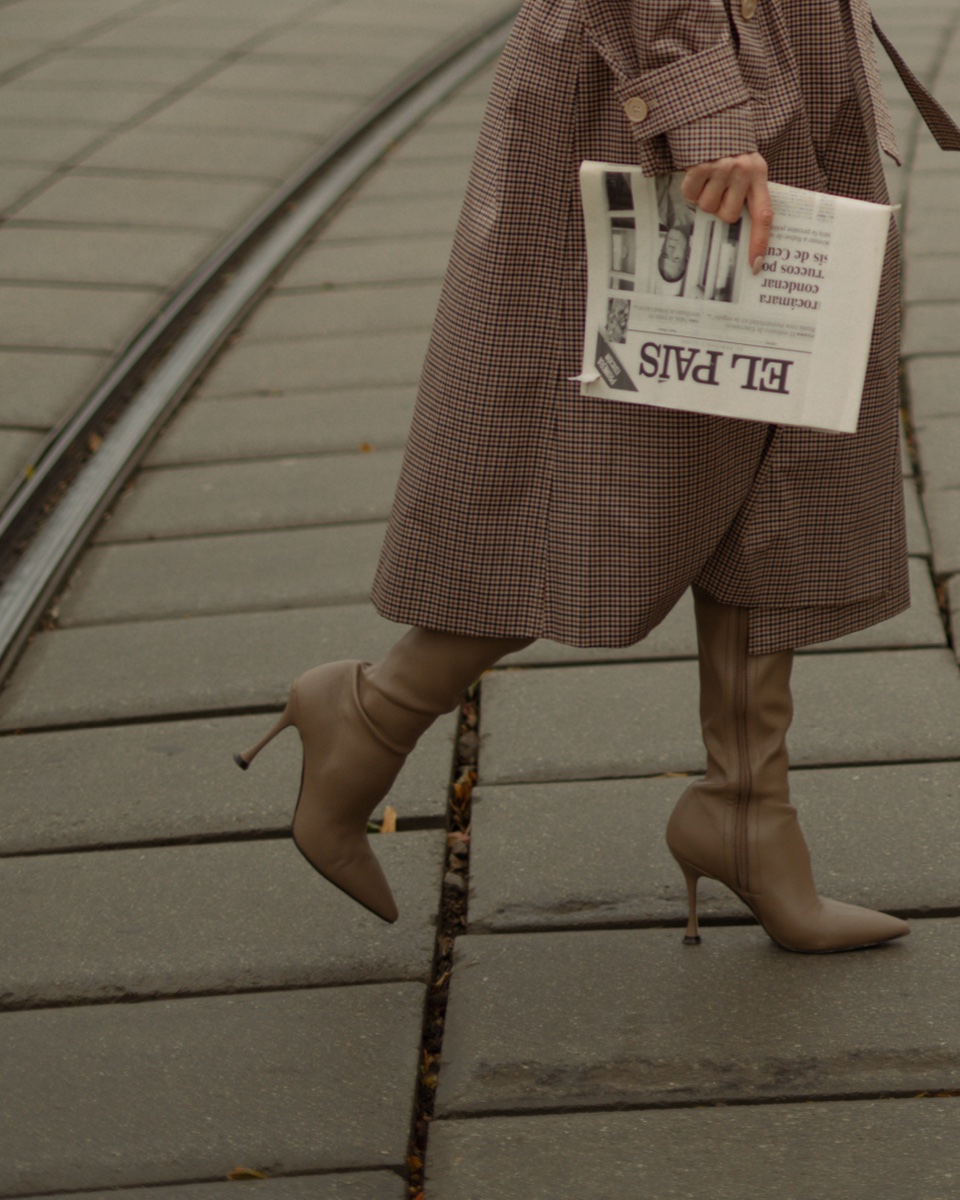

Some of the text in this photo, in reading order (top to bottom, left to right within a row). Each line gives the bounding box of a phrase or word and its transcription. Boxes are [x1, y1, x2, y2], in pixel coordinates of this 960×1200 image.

[765, 246, 790, 261] Ceu
[794, 249, 810, 263] de
[761, 261, 824, 279] ruecos po
[761, 278, 819, 294] condenar
[759, 294, 821, 310] rocámara
[639, 342, 723, 386] PAÍS
[731, 354, 794, 394] EL
